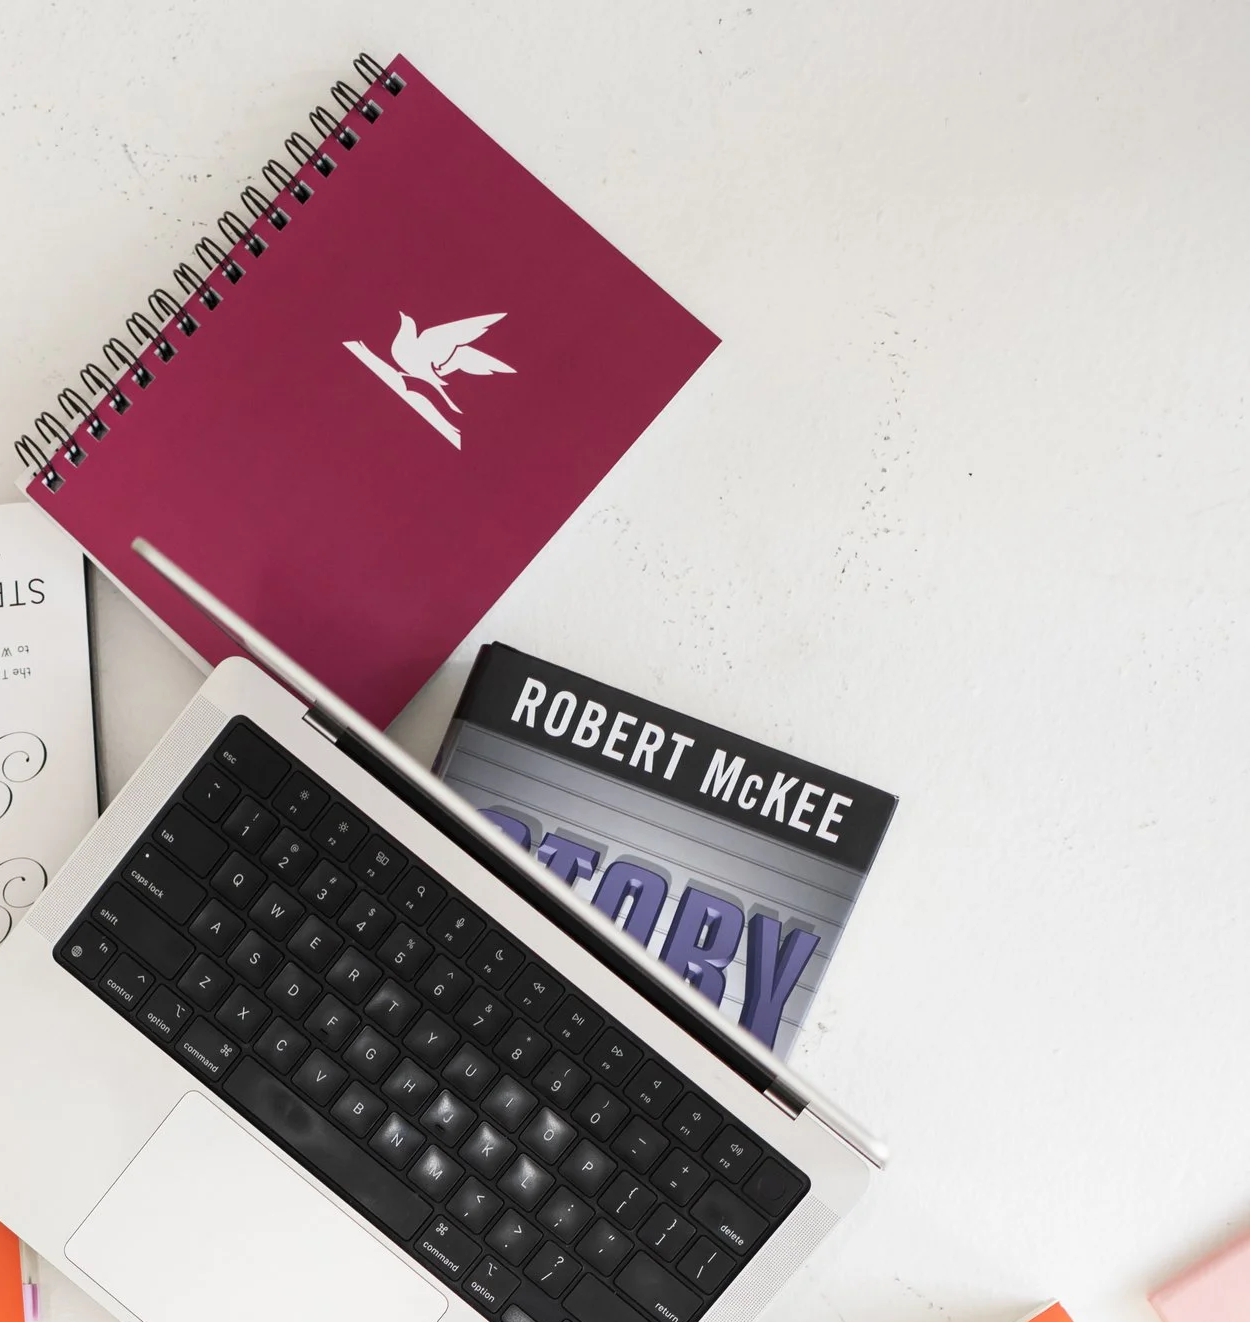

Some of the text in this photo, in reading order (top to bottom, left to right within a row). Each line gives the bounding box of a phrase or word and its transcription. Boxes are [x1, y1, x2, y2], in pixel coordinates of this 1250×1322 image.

[17, 645, 30, 654] to
[12, 667, 32, 679] the
[510, 676, 853, 844] ROBERT McKEE
[476, 808, 821, 1052] TORY
[106, 979, 134, 1002] control
[147, 1012, 171, 1034] option
[183, 1042, 219, 1073] command
[720, 1225, 744, 1246] delete
